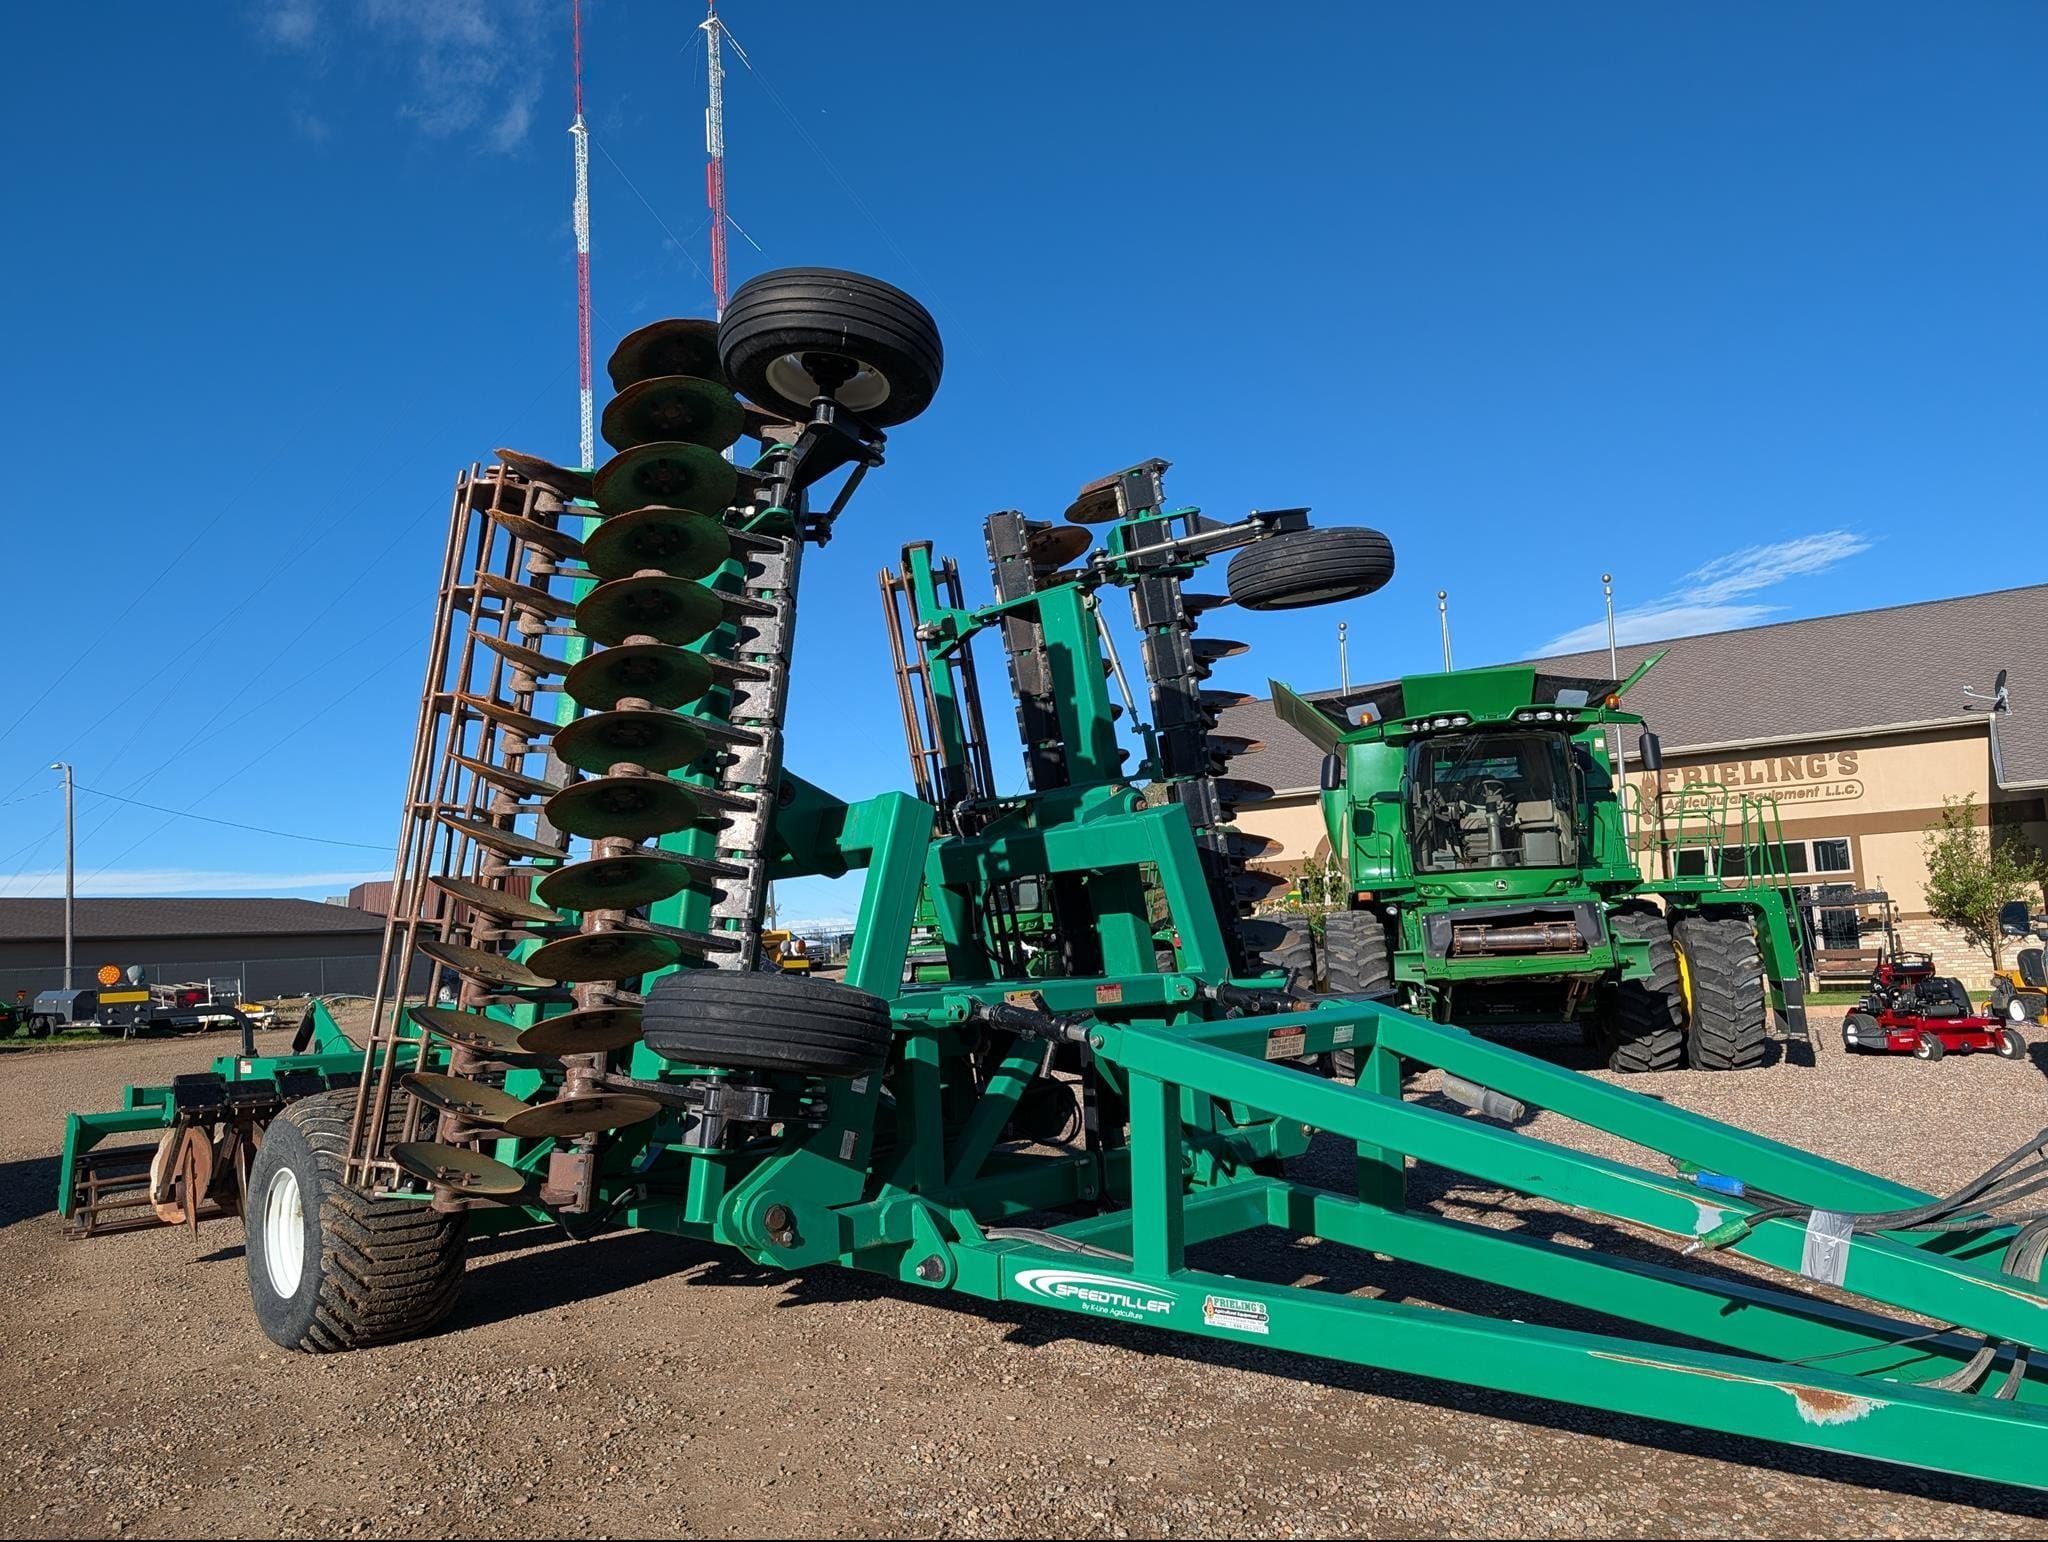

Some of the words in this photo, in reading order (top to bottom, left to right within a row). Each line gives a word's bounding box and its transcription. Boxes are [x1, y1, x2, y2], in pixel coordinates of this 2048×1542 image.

[1660, 751, 1859, 792] FRIELING'S
[1665, 792, 1742, 811] Agricutual
[1825, 784, 1858, 797] L.L.C.
[1055, 1284, 1171, 1314] SPEEDTILLER
[1082, 1302, 1090, 1311] By
[1090, 1303, 1109, 1314] K-Line
[1110, 1307, 1144, 1320] Agriculture
[1213, 1297, 1265, 1313] FRIELING'S
